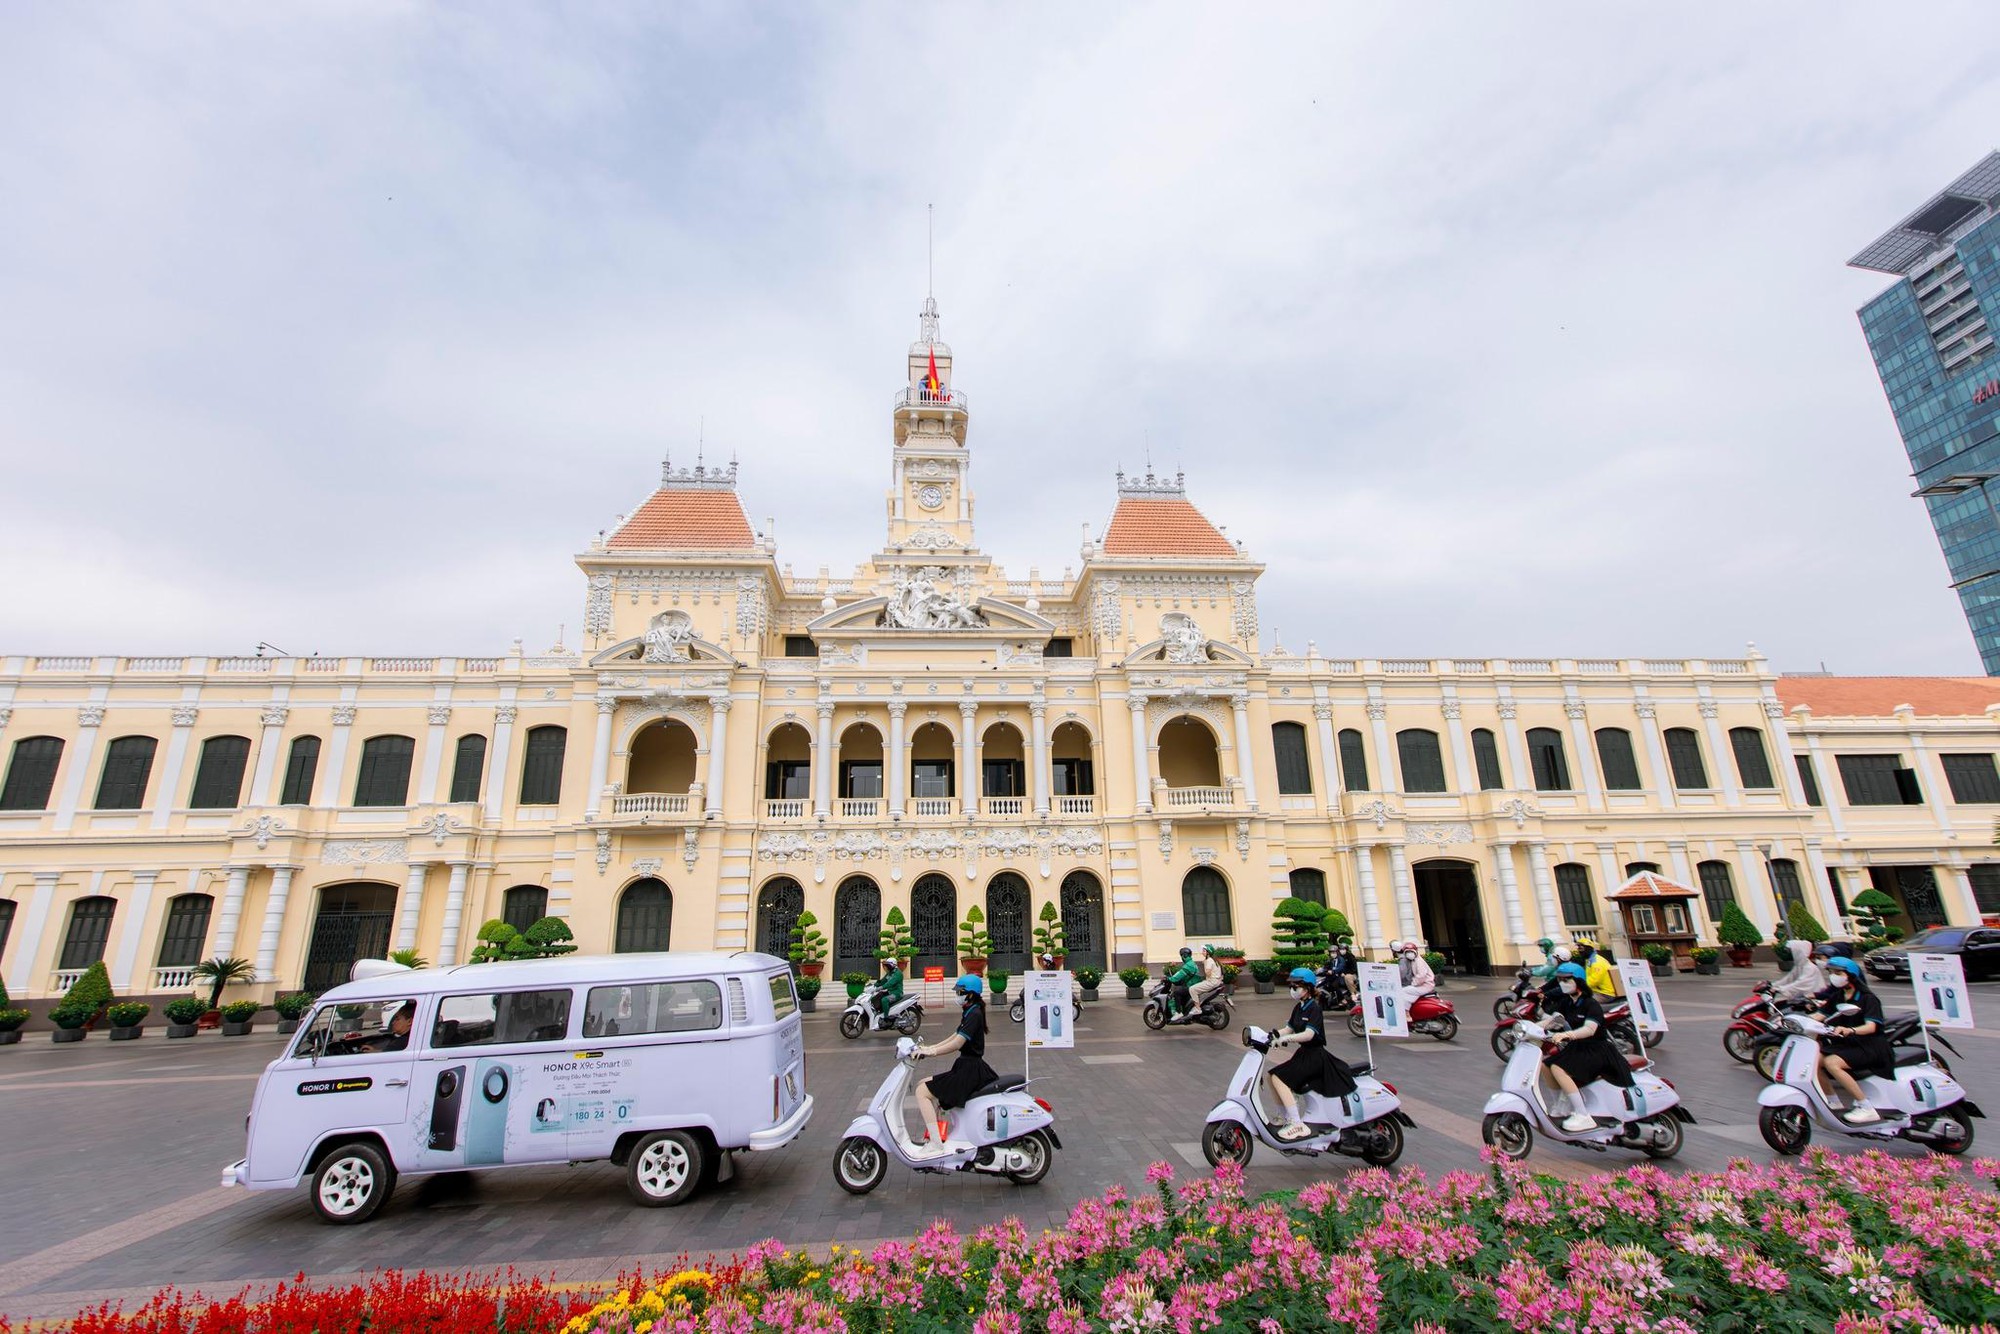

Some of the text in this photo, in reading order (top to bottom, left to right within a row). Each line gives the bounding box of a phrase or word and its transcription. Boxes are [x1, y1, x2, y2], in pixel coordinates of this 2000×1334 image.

[543, 1062, 577, 1072] HONOR
[579, 1061, 594, 1070] X9c
[596, 1060, 620, 1069] Smart
[302, 1084, 330, 1092] HONOR
[575, 1110, 604, 1120] 180 24
